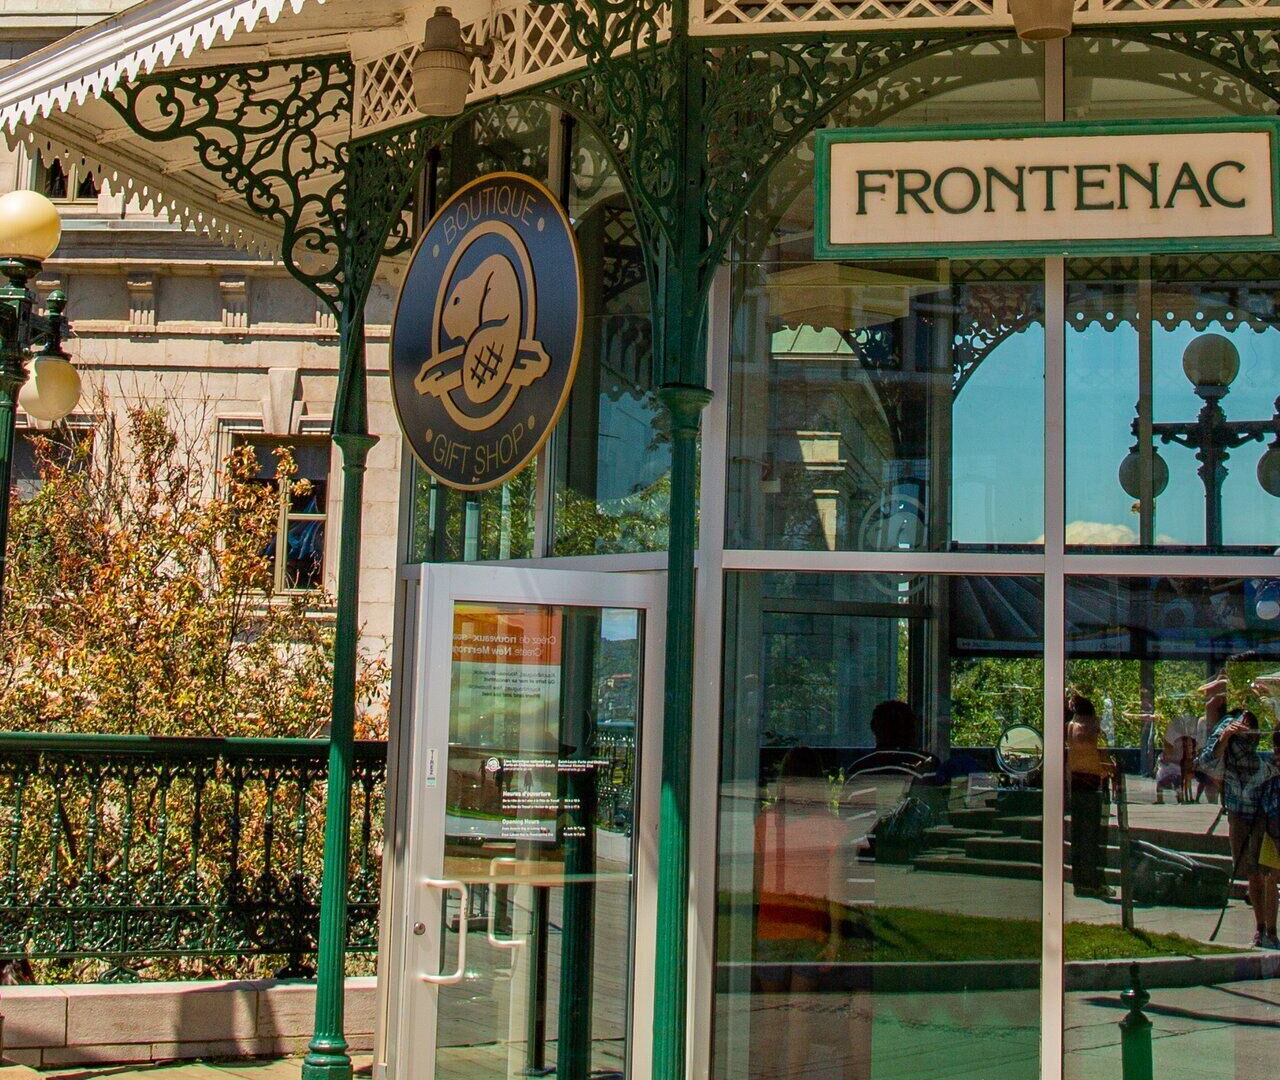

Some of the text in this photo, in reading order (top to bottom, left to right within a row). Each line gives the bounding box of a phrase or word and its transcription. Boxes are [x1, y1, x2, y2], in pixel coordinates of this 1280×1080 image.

[856, 161, 1246, 215] FRONTENAC
[443, 185, 537, 246] BOUTIQUE
[433, 423, 524, 475] GIFT SHOP
